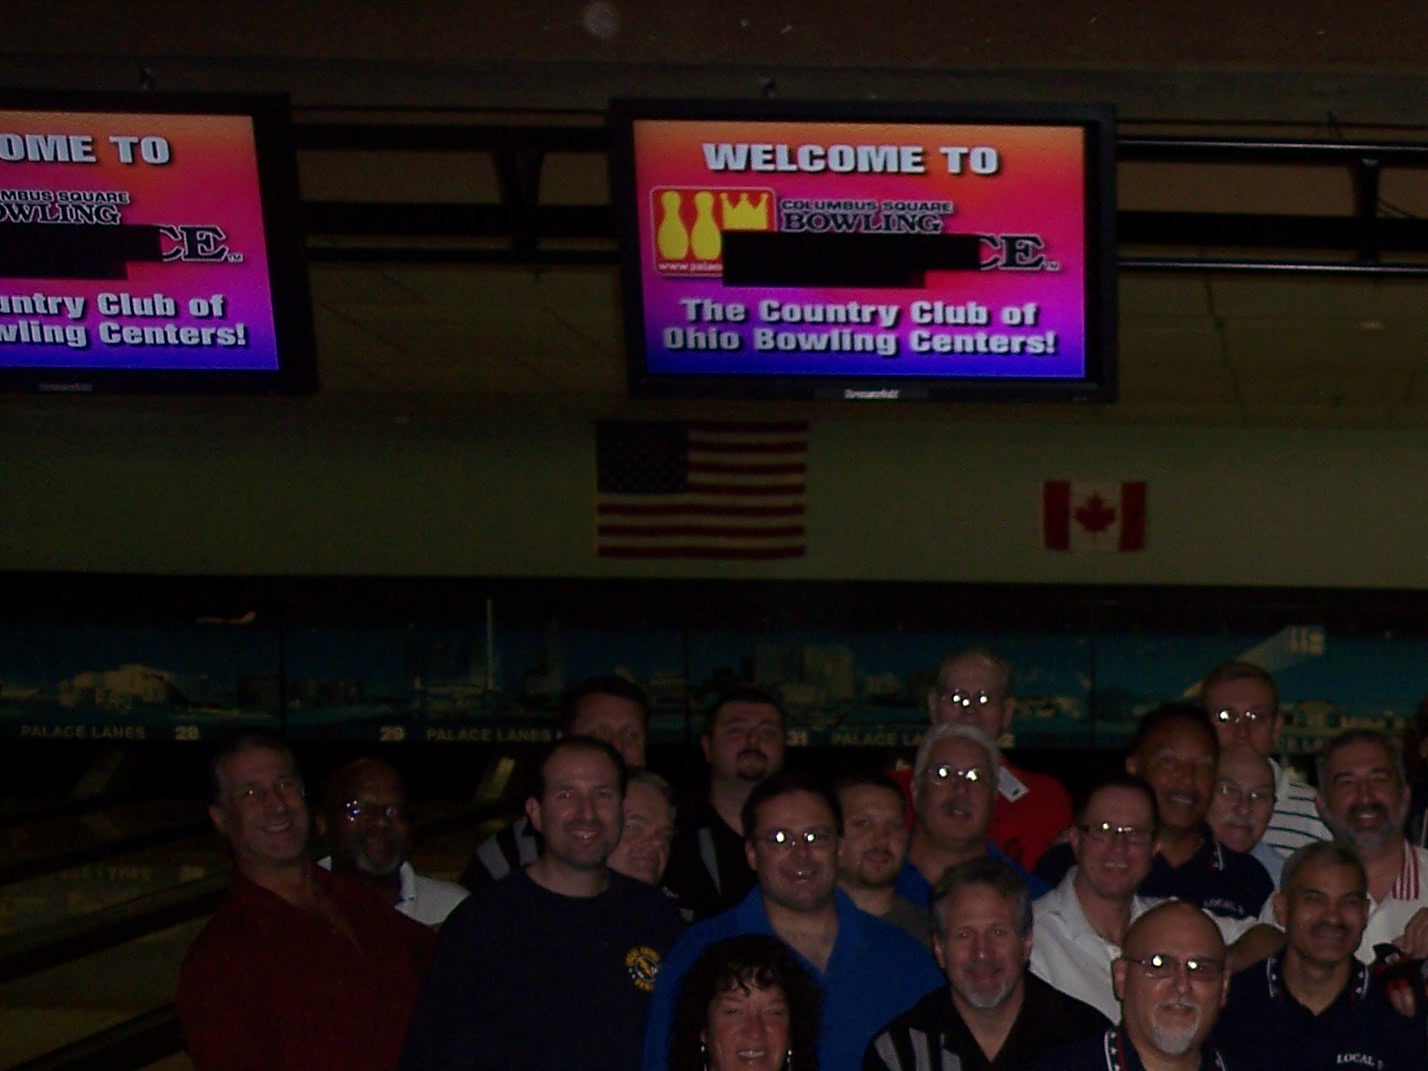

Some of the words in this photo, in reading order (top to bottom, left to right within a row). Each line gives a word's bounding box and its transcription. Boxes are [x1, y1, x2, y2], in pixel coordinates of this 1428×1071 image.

[109, 135, 171, 164] TO
[702, 143, 926, 174] WELCOME
[940, 146, 1000, 175] TO
[58, 191, 130, 204] SQUARE
[781, 200, 877, 211] COLUMBUS
[881, 201, 953, 213] SQUARE
[784, 212, 941, 233] BOWLING
[97, 292, 176, 317] Club
[189, 294, 225, 317] of
[680, 299, 746, 323] The
[759, 300, 899, 327] Country
[911, 300, 989, 326] Club
[1002, 302, 1038, 326] of
[100, 322, 247, 346] Centers!
[663, 327, 741, 351] Ohio
[754, 328, 897, 356] Bowling
[910, 330, 1056, 354] Centers!
[20, 725, 86, 739] PALACE
[92, 725, 146, 740] LANES
[427, 727, 490, 742] PALACE
[496, 727, 551, 742] LANES
[831, 731, 896, 747] PALACE
[1336, 1052, 1375, 1067] LOCAL
